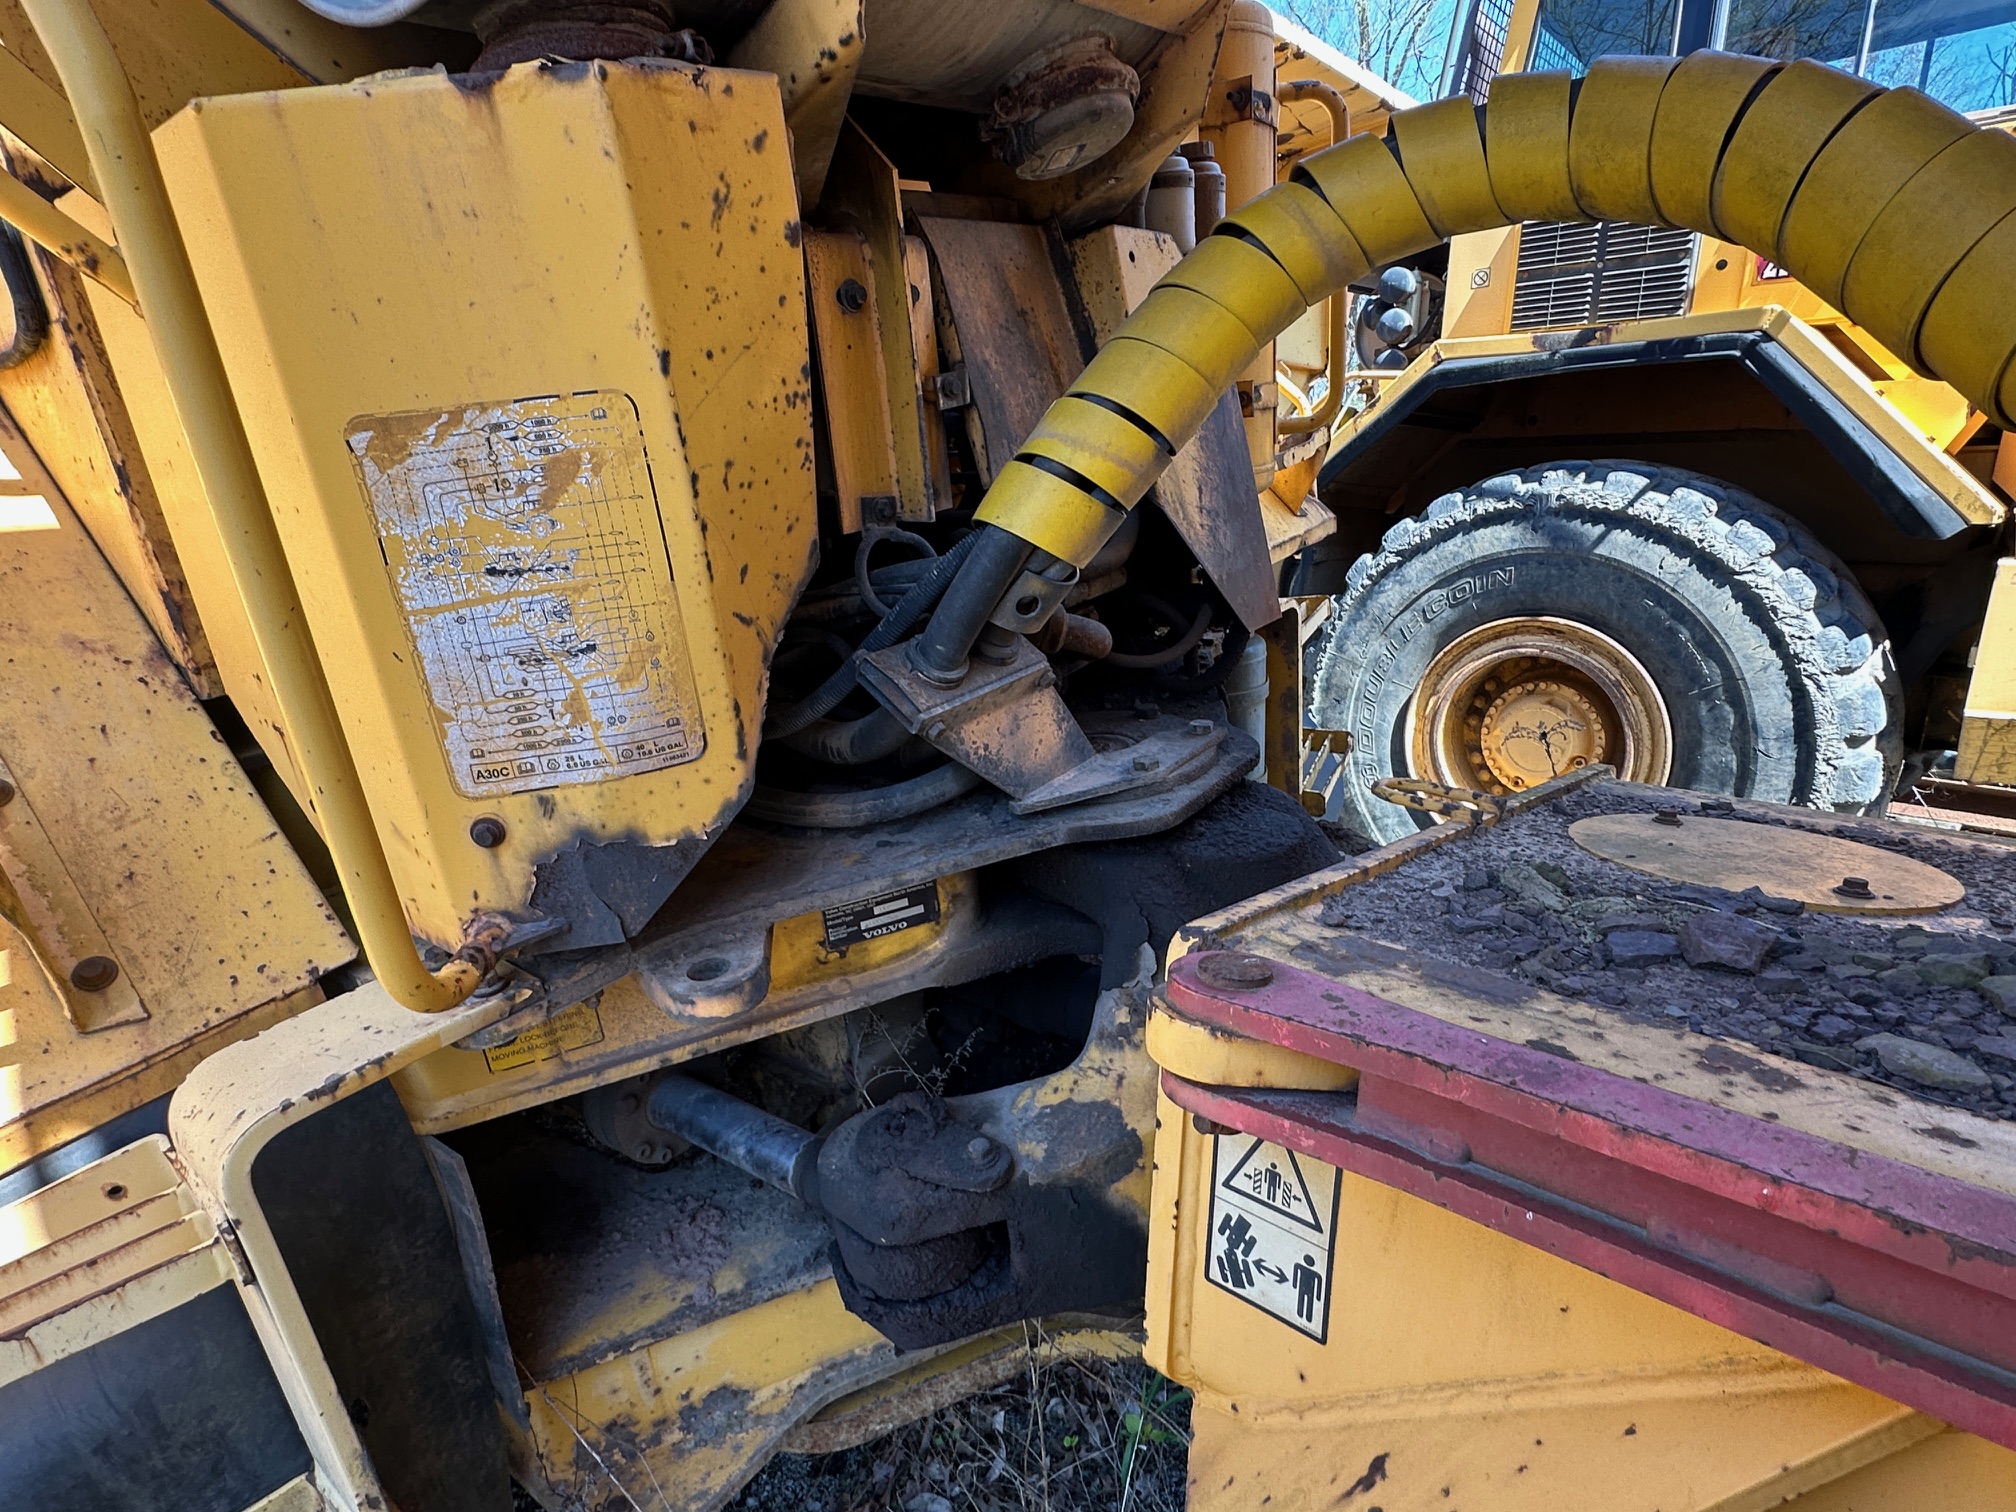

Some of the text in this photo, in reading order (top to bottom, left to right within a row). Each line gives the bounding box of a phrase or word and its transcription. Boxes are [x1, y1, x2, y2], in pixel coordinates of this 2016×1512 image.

[654, 745, 666, 753] US
[666, 741, 683, 750] GAL
[579, 759, 591, 767] US
[476, 767, 510, 780] A30C
[862, 921, 908, 939] VOLVO
[519, 1032, 542, 1043] LOCK
[490, 1047, 525, 1062] MOVING
